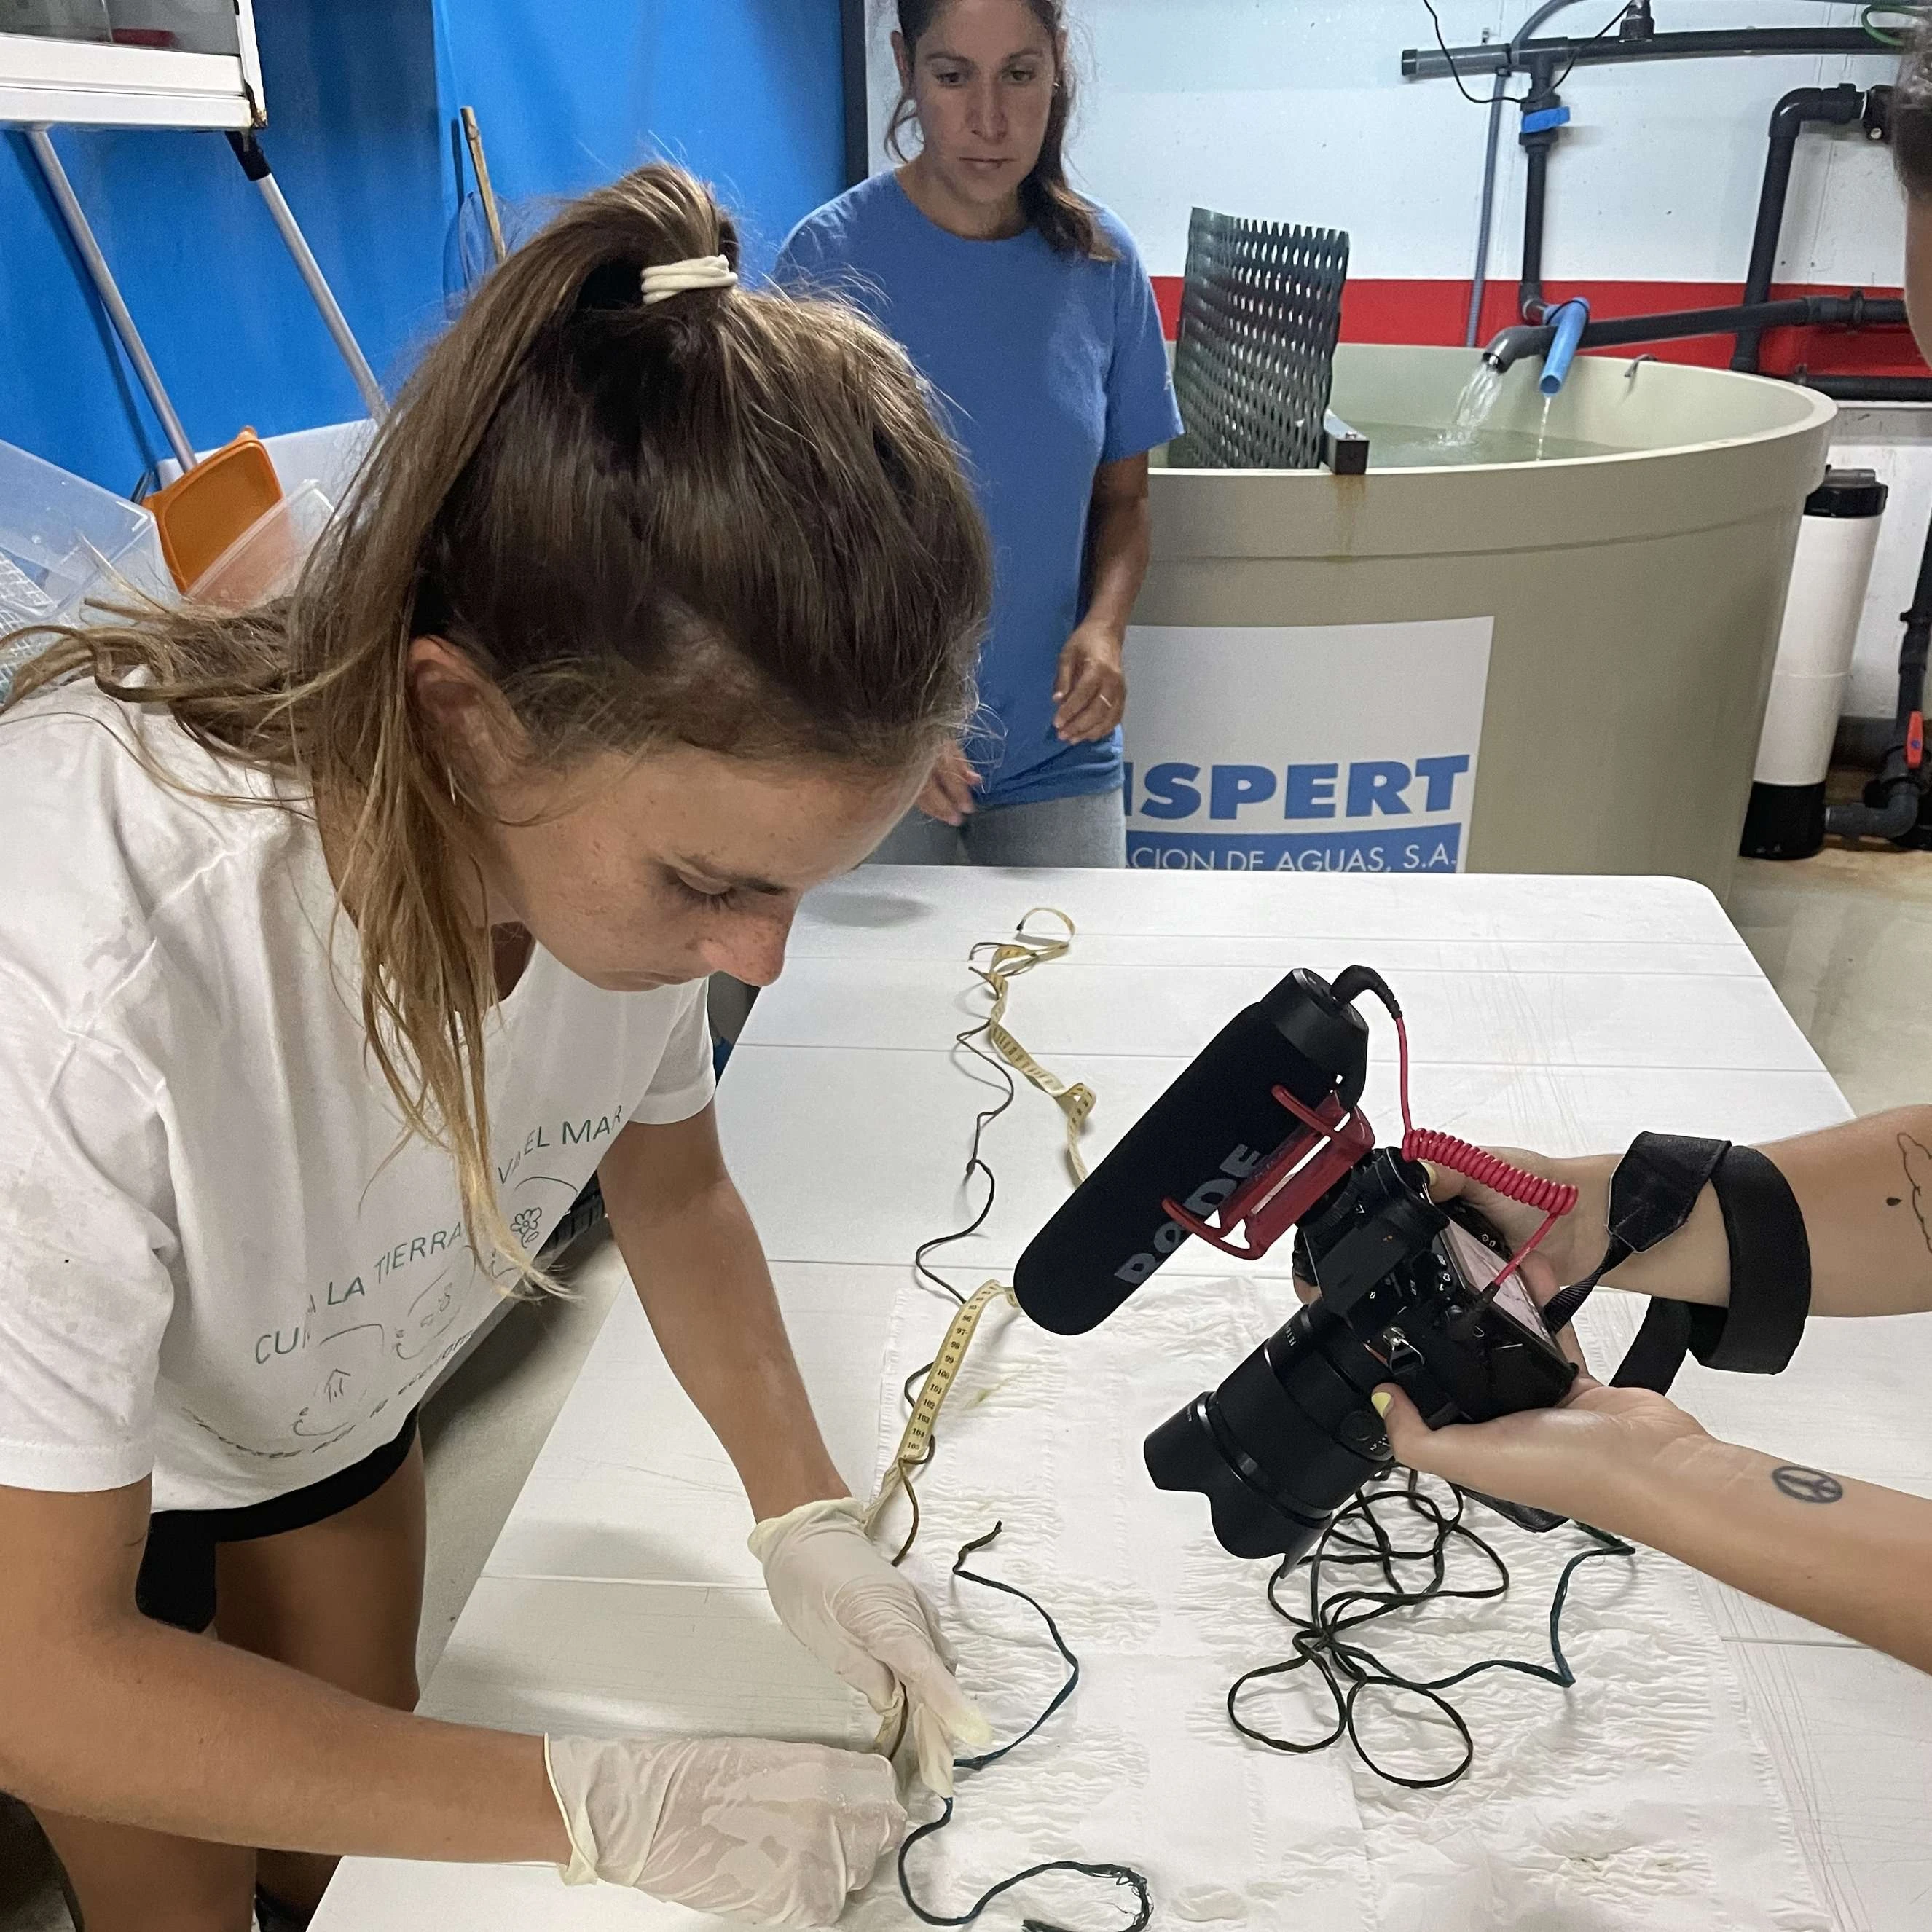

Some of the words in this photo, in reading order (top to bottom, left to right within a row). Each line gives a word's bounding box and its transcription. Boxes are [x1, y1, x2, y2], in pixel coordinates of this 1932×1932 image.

[1126, 847, 1215, 871] CION
[1227, 850, 1265, 871] DE
[328, 1276, 365, 1305] LA
[374, 1221, 462, 1284] TIERRA
[944, 1355, 954, 1364] 99
[930, 1383, 943, 1395] 101
[923, 1399, 936, 1410] 102
[917, 1413, 930, 1424] 103
[912, 1427, 925, 1438] 104
